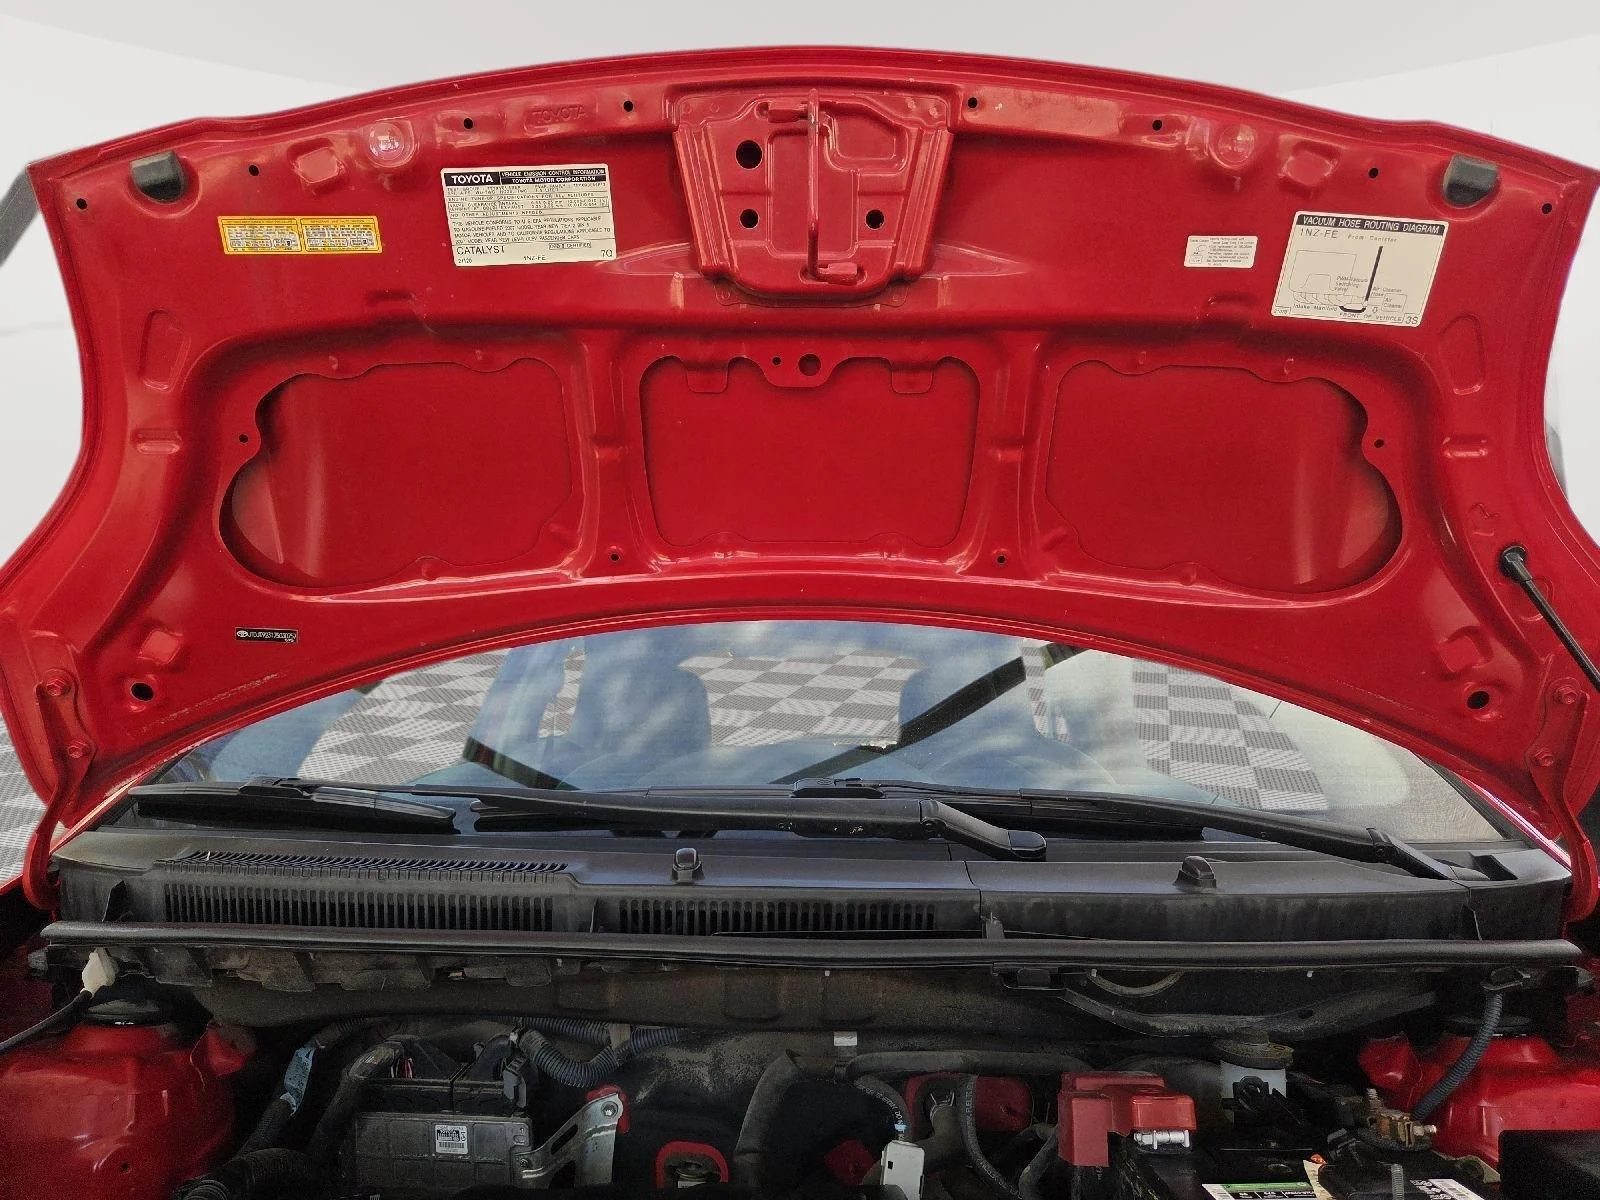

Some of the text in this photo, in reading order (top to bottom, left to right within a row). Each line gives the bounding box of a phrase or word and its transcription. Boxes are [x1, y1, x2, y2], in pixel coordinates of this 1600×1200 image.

[452, 174, 494, 184] TOYOTA
[1303, 216, 1440, 234] VACUUM HOSE ROUTING DIAGRAM
[1300, 228, 1338, 238] 1NZ-FE
[456, 245, 505, 254] CATALYST
[1405, 316, 1418, 325] 3S
